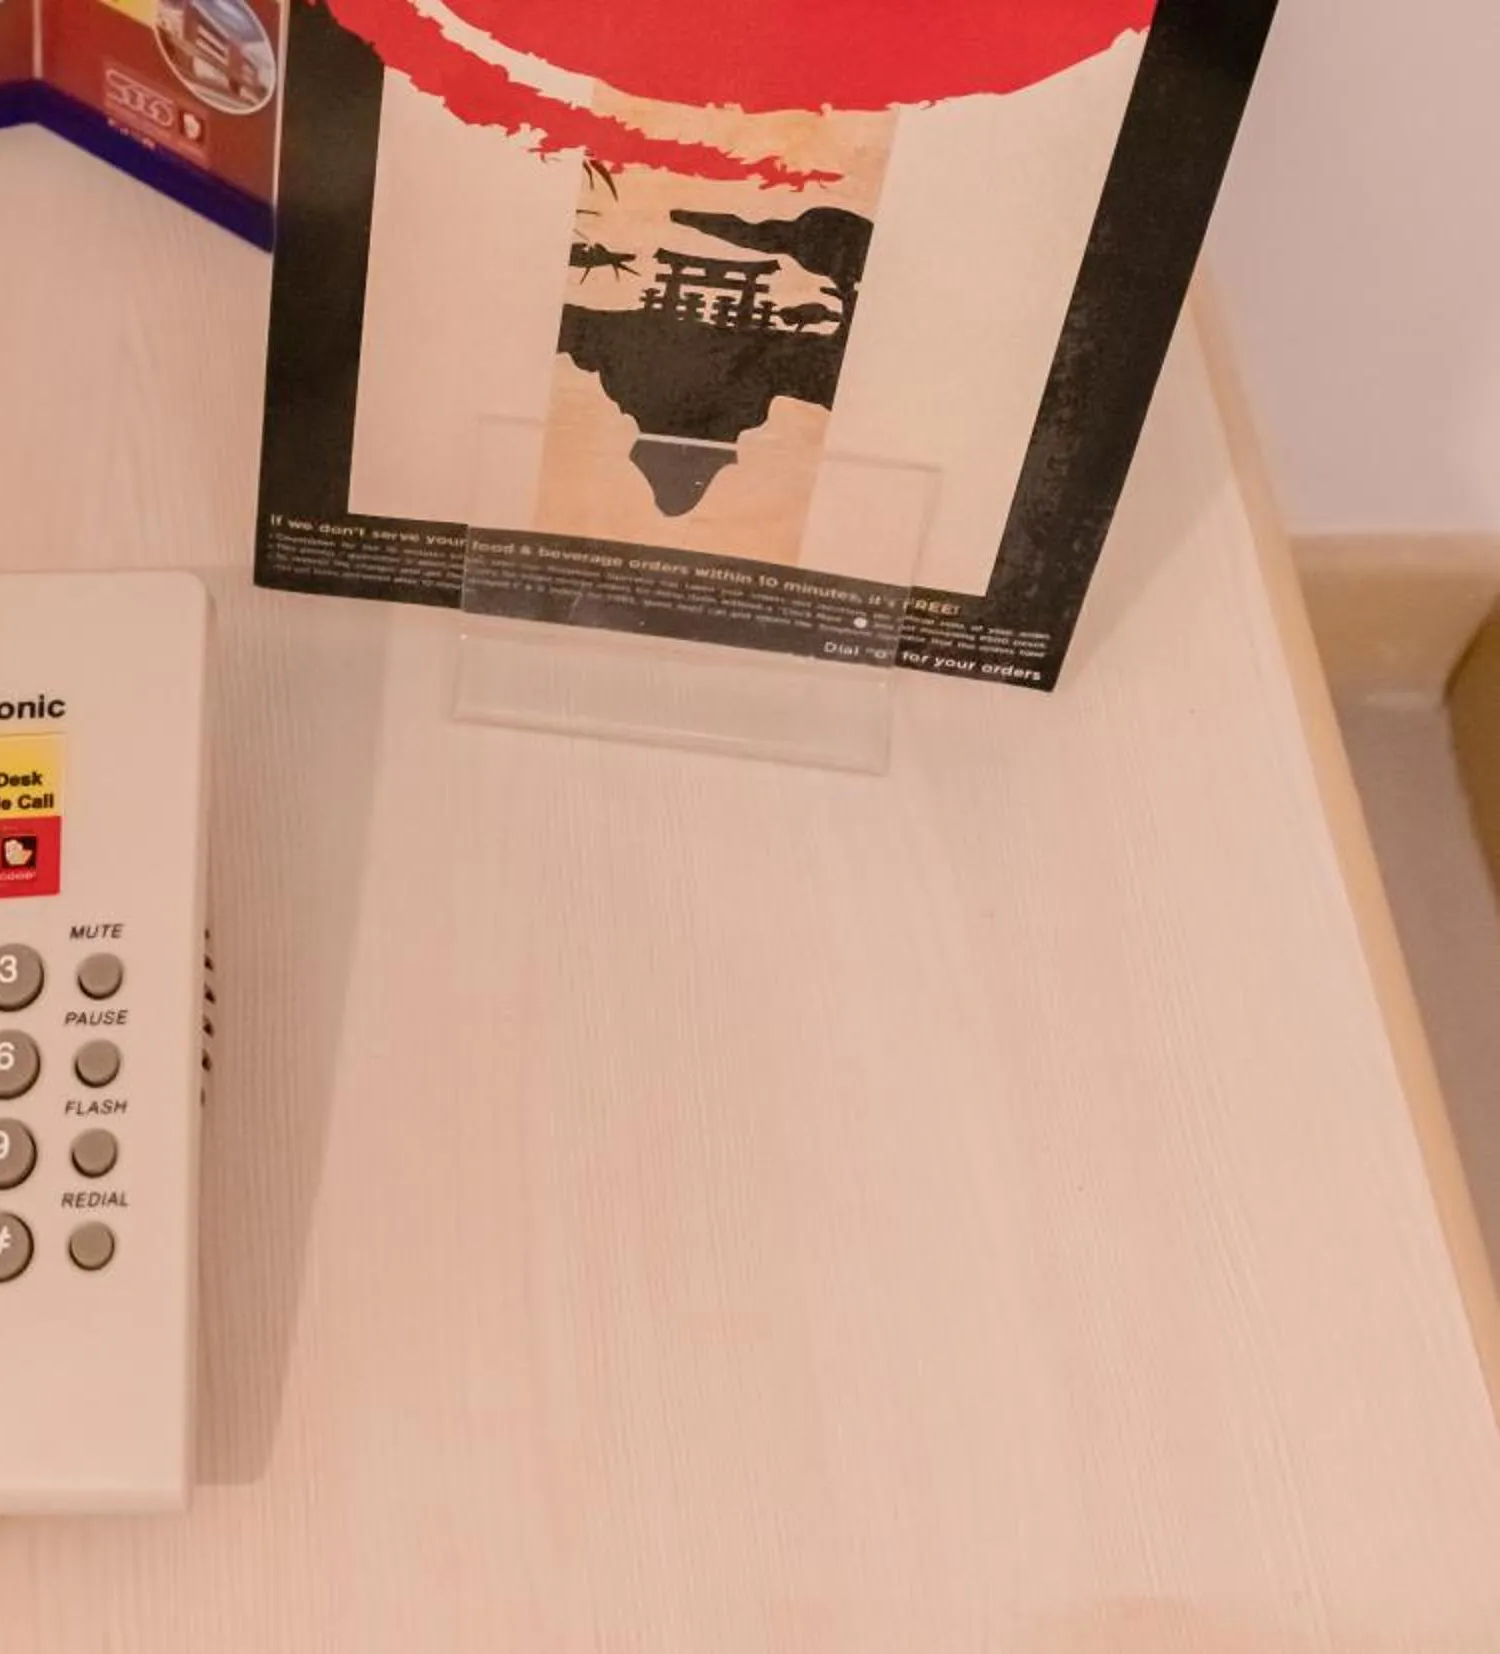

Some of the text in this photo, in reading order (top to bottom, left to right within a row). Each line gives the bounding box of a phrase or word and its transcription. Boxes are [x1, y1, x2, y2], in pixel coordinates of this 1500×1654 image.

[270, 514, 283, 527] If
[288, 519, 313, 532] we
[319, 523, 366, 537] don't
[372, 530, 421, 543] serve
[426, 534, 468, 548] your
[472, 540, 515, 555] food
[538, 547, 623, 568] beverage
[628, 558, 689, 576] orders
[695, 567, 753, 585] within
[758, 574, 779, 588] 10
[824, 640, 859, 657] Dial
[902, 650, 929, 663] for
[934, 655, 976, 671] your
[981, 662, 1042, 681] orders
[17, 793, 55, 811] Call
[70, 923, 124, 941] MUTE
[64, 1009, 129, 1027] PAUSE
[64, 1098, 128, 1116] FLASH
[61, 1191, 129, 1209] REDIAL
